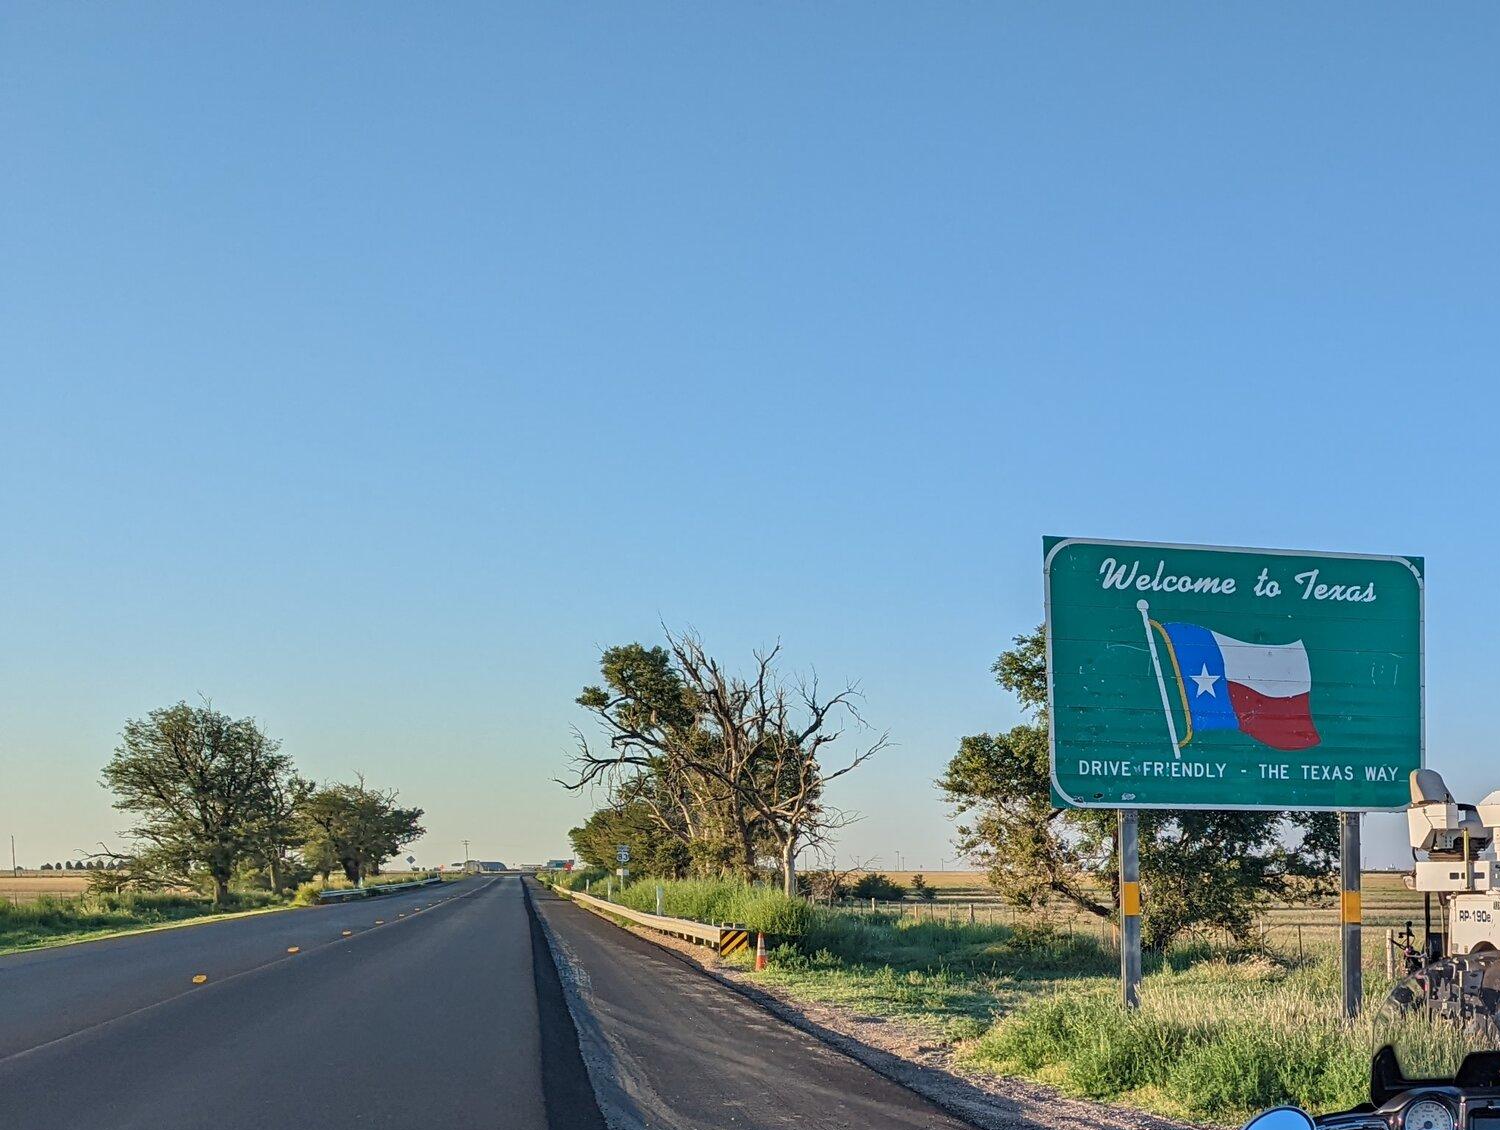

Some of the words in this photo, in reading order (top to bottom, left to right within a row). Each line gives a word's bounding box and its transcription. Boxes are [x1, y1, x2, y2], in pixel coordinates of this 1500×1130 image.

[1099, 557, 1236, 594] Welcome
[1254, 568, 1281, 597] to
[1295, 569, 1376, 602] Texas
[1079, 760, 1131, 776] DRIVE
[1143, 762, 1226, 778] FRIENDLY
[1259, 764, 1289, 780] THE
[1301, 765, 1354, 781] TEXAS
[1364, 766, 1399, 781] WAY
